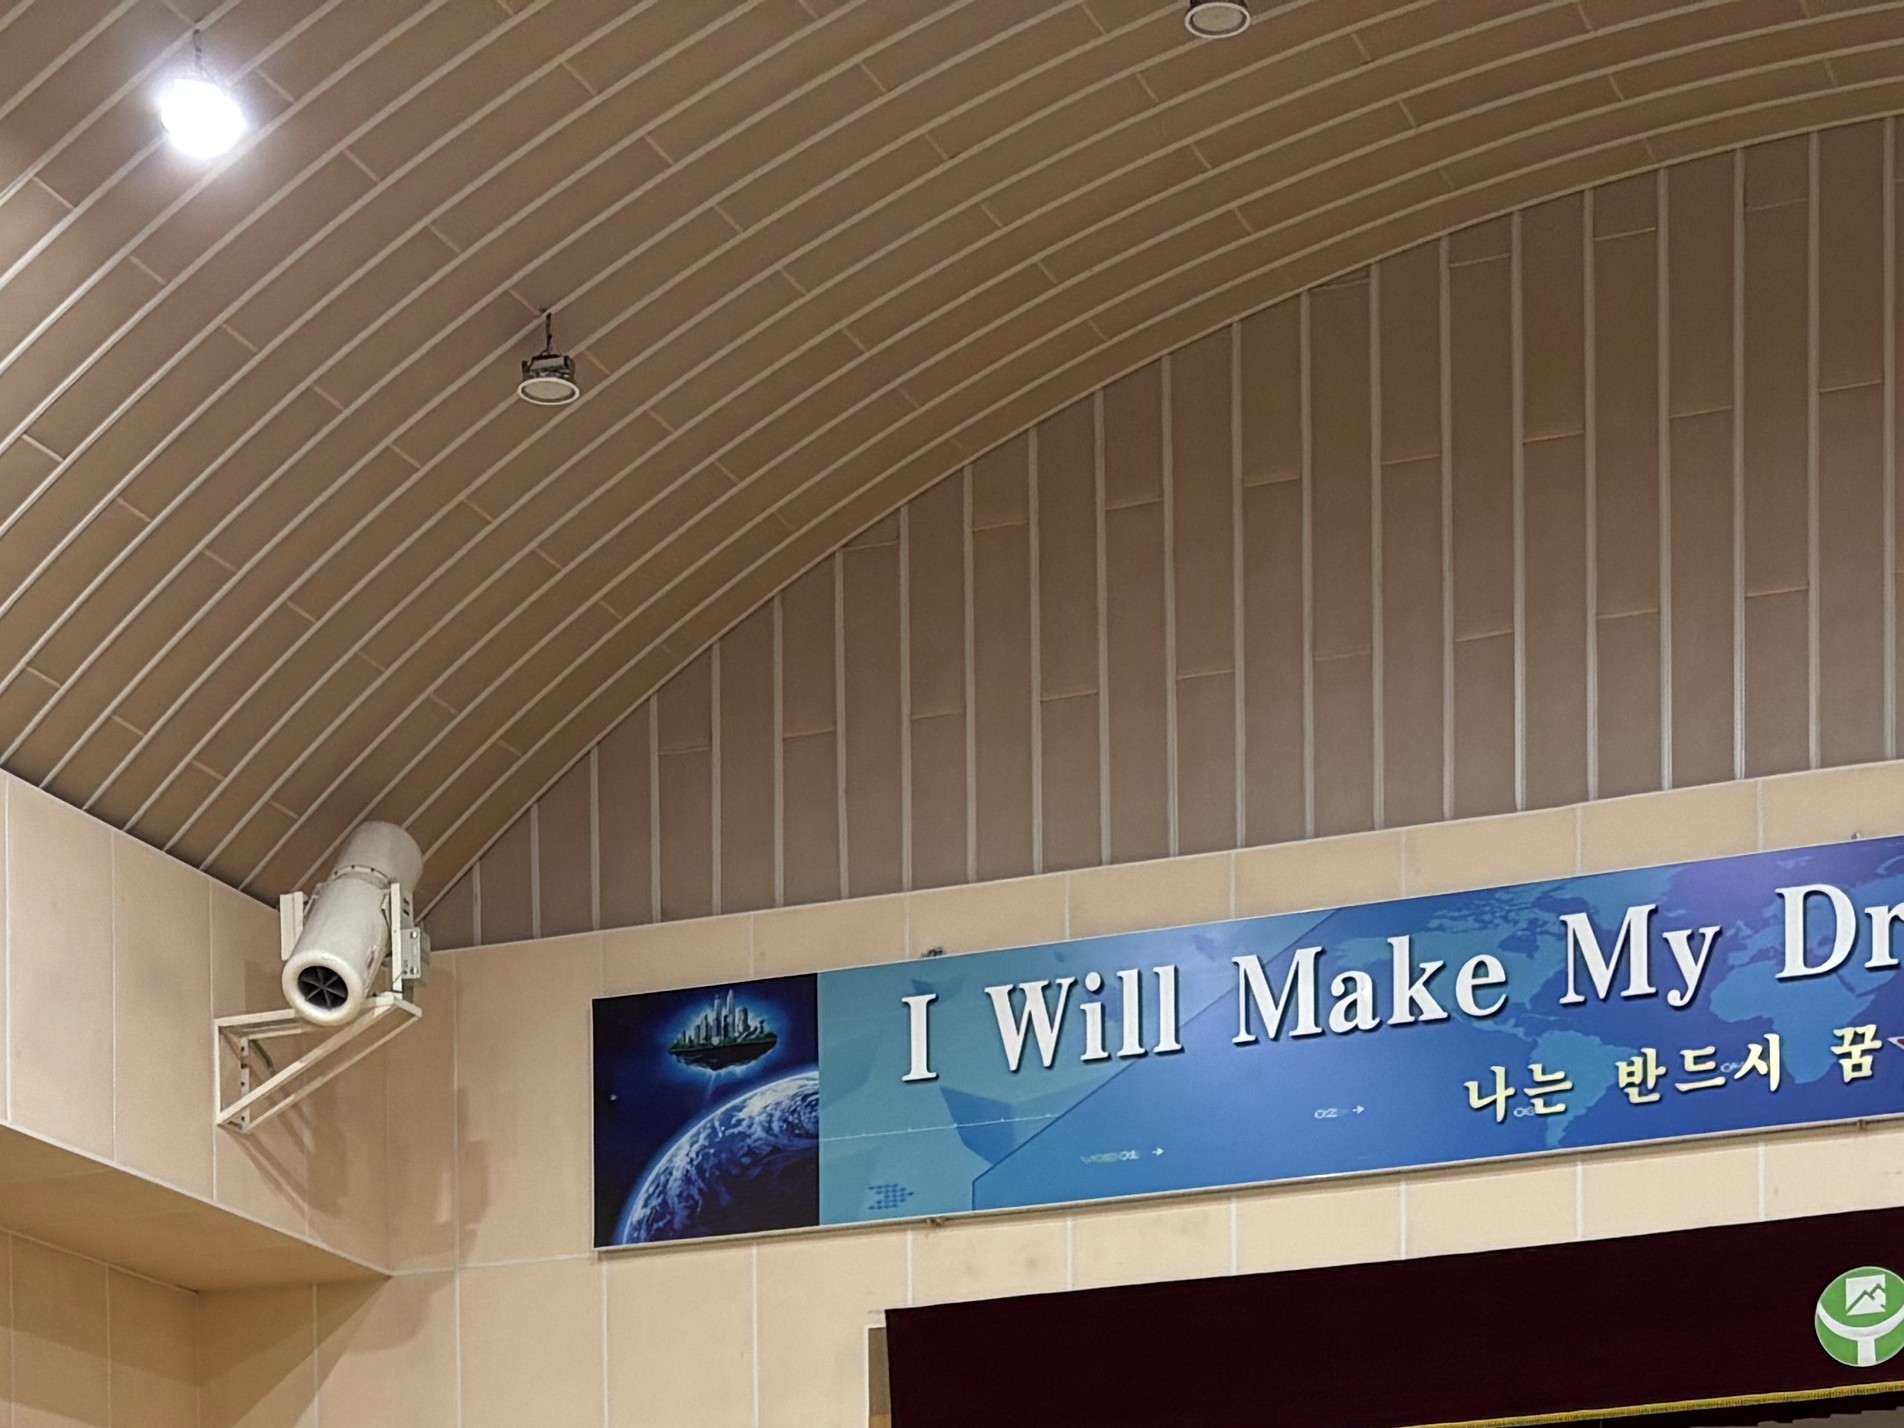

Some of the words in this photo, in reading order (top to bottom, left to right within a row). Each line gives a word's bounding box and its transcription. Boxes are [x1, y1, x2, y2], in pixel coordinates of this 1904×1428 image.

[902, 992, 940, 1083] I
[984, 964, 1184, 1073] Will
[1231, 935, 1508, 1047] Make
[1559, 902, 1721, 1007] My
[1463, 1062, 1574, 1123] 나는
[1613, 1032, 1782, 1105] 반드시
